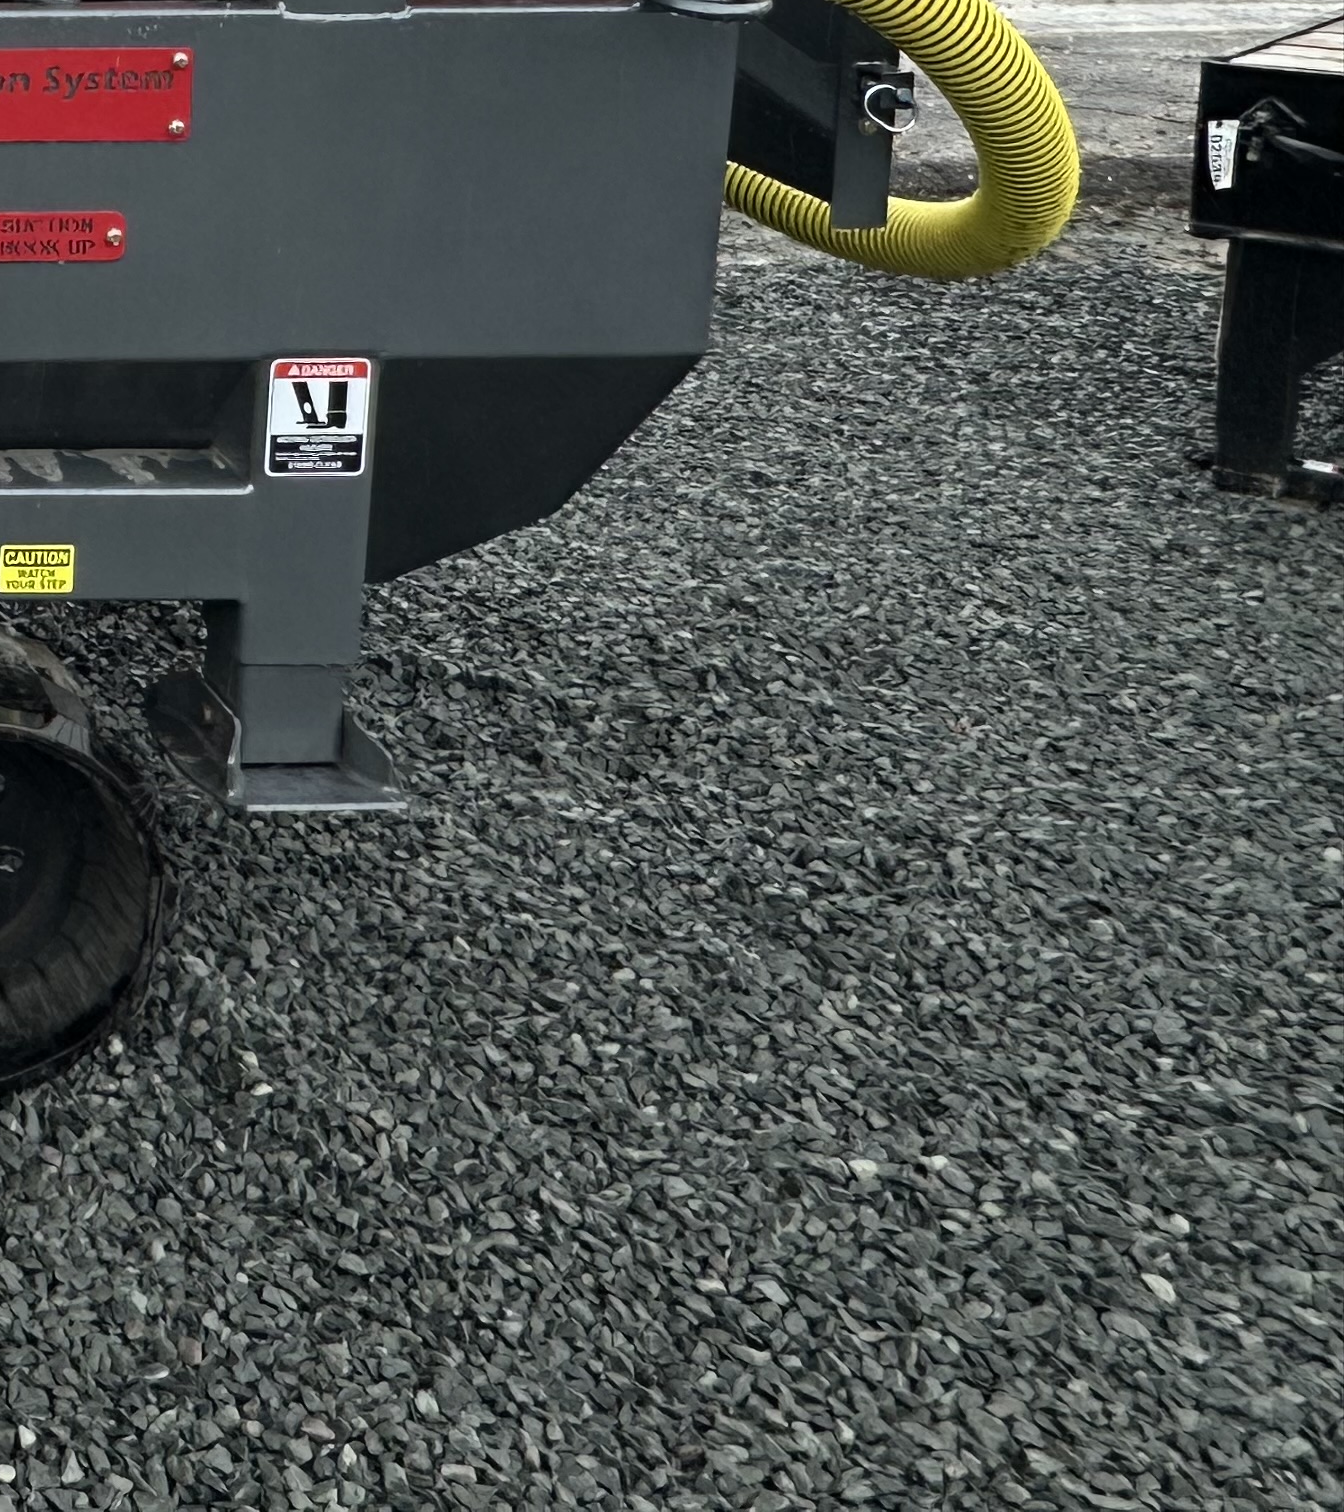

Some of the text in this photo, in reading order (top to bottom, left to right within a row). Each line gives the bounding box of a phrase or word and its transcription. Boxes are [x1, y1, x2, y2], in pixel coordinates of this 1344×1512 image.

[42, 66, 174, 100] System
[69, 240, 96, 254] UP
[301, 364, 354, 376] DANGER
[5, 551, 69, 565] CAUTION
[18, 569, 55, 578] WATCH
[6, 579, 66, 589] YOUR STEP
